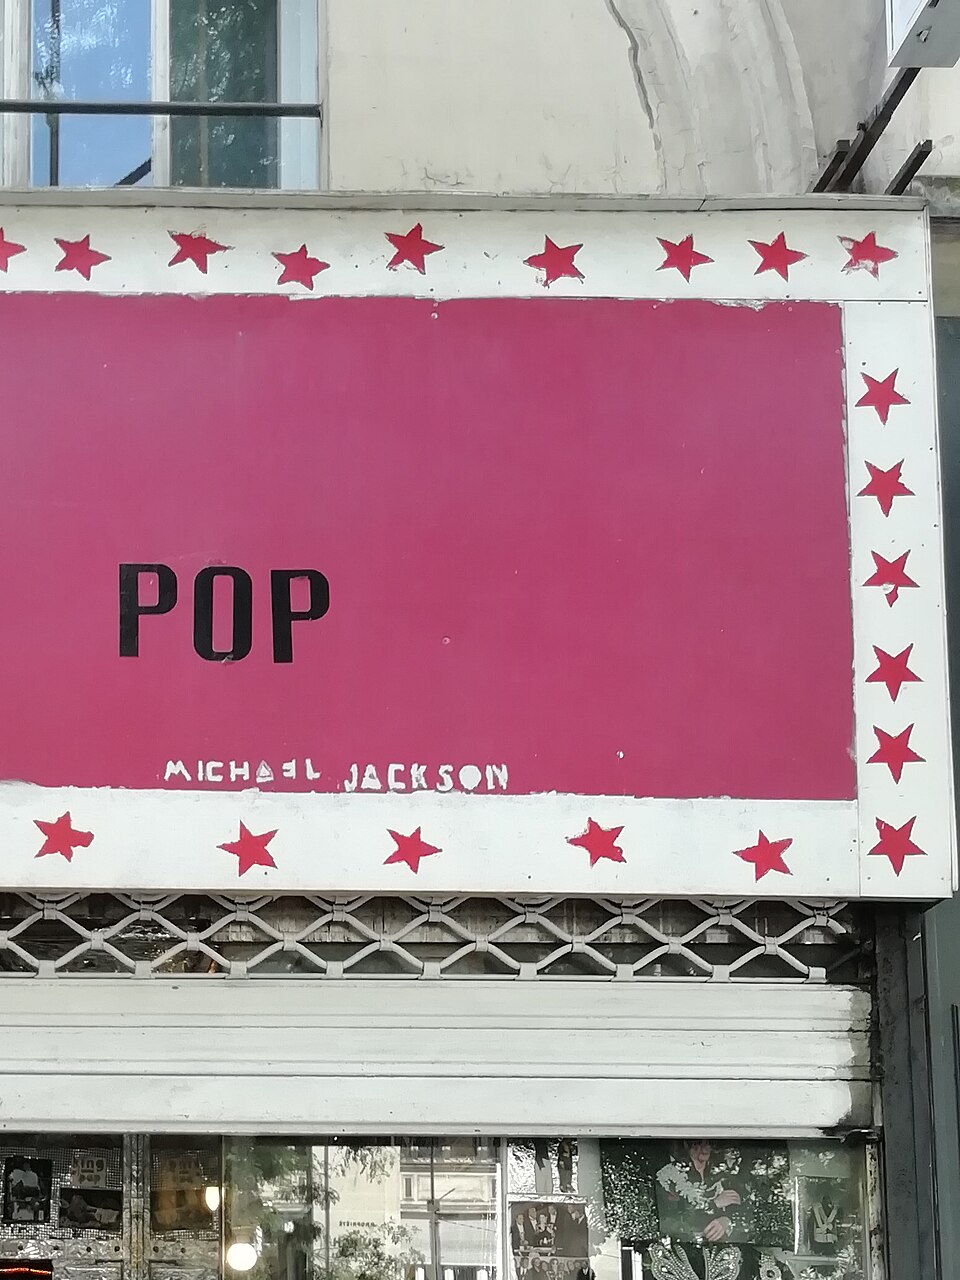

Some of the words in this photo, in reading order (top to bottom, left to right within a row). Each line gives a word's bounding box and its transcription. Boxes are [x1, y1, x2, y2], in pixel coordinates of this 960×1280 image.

[119, 563, 331, 664] POP
[164, 759, 321, 783] MICHAEL
[344, 763, 508, 792] JACKSON
